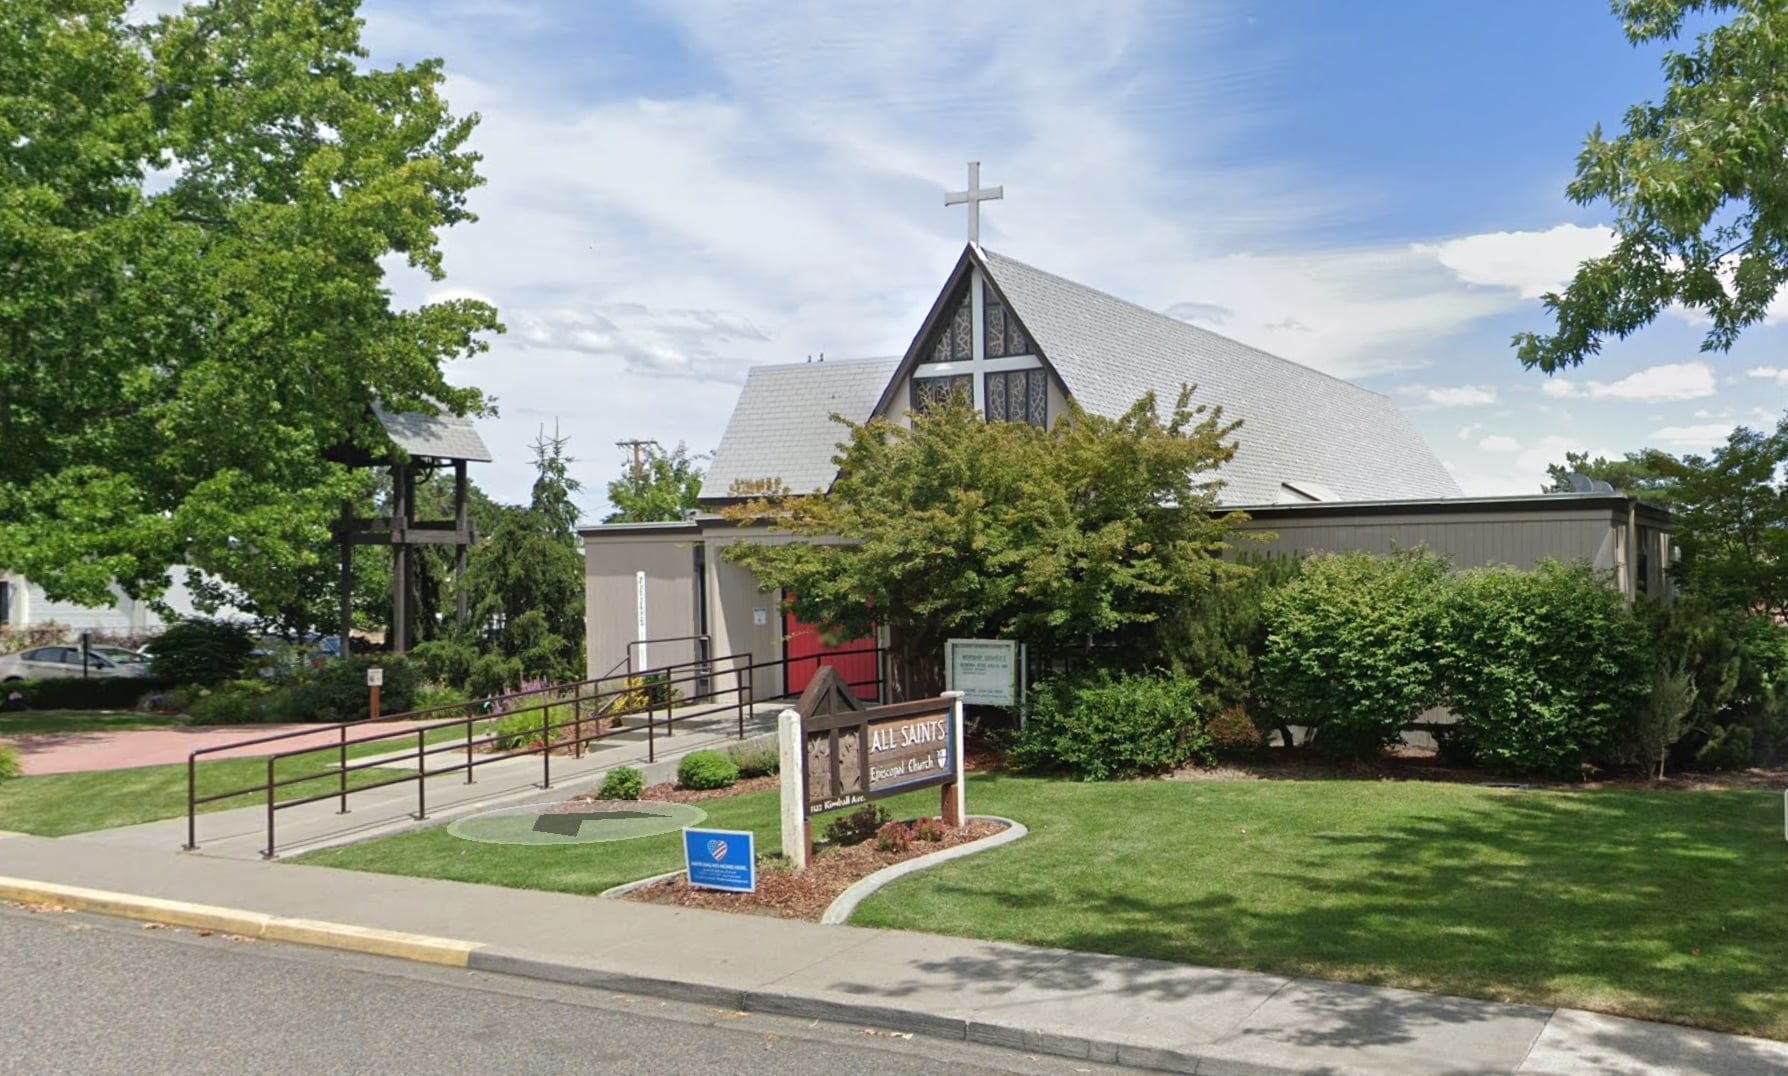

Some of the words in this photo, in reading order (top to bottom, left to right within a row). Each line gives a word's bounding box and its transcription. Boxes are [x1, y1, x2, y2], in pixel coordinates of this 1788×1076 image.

[871, 730, 897, 753] ALL
[901, 720, 945, 746] SAINTS
[870, 760, 904, 782] Episcopal
[908, 754, 933, 773] Church
